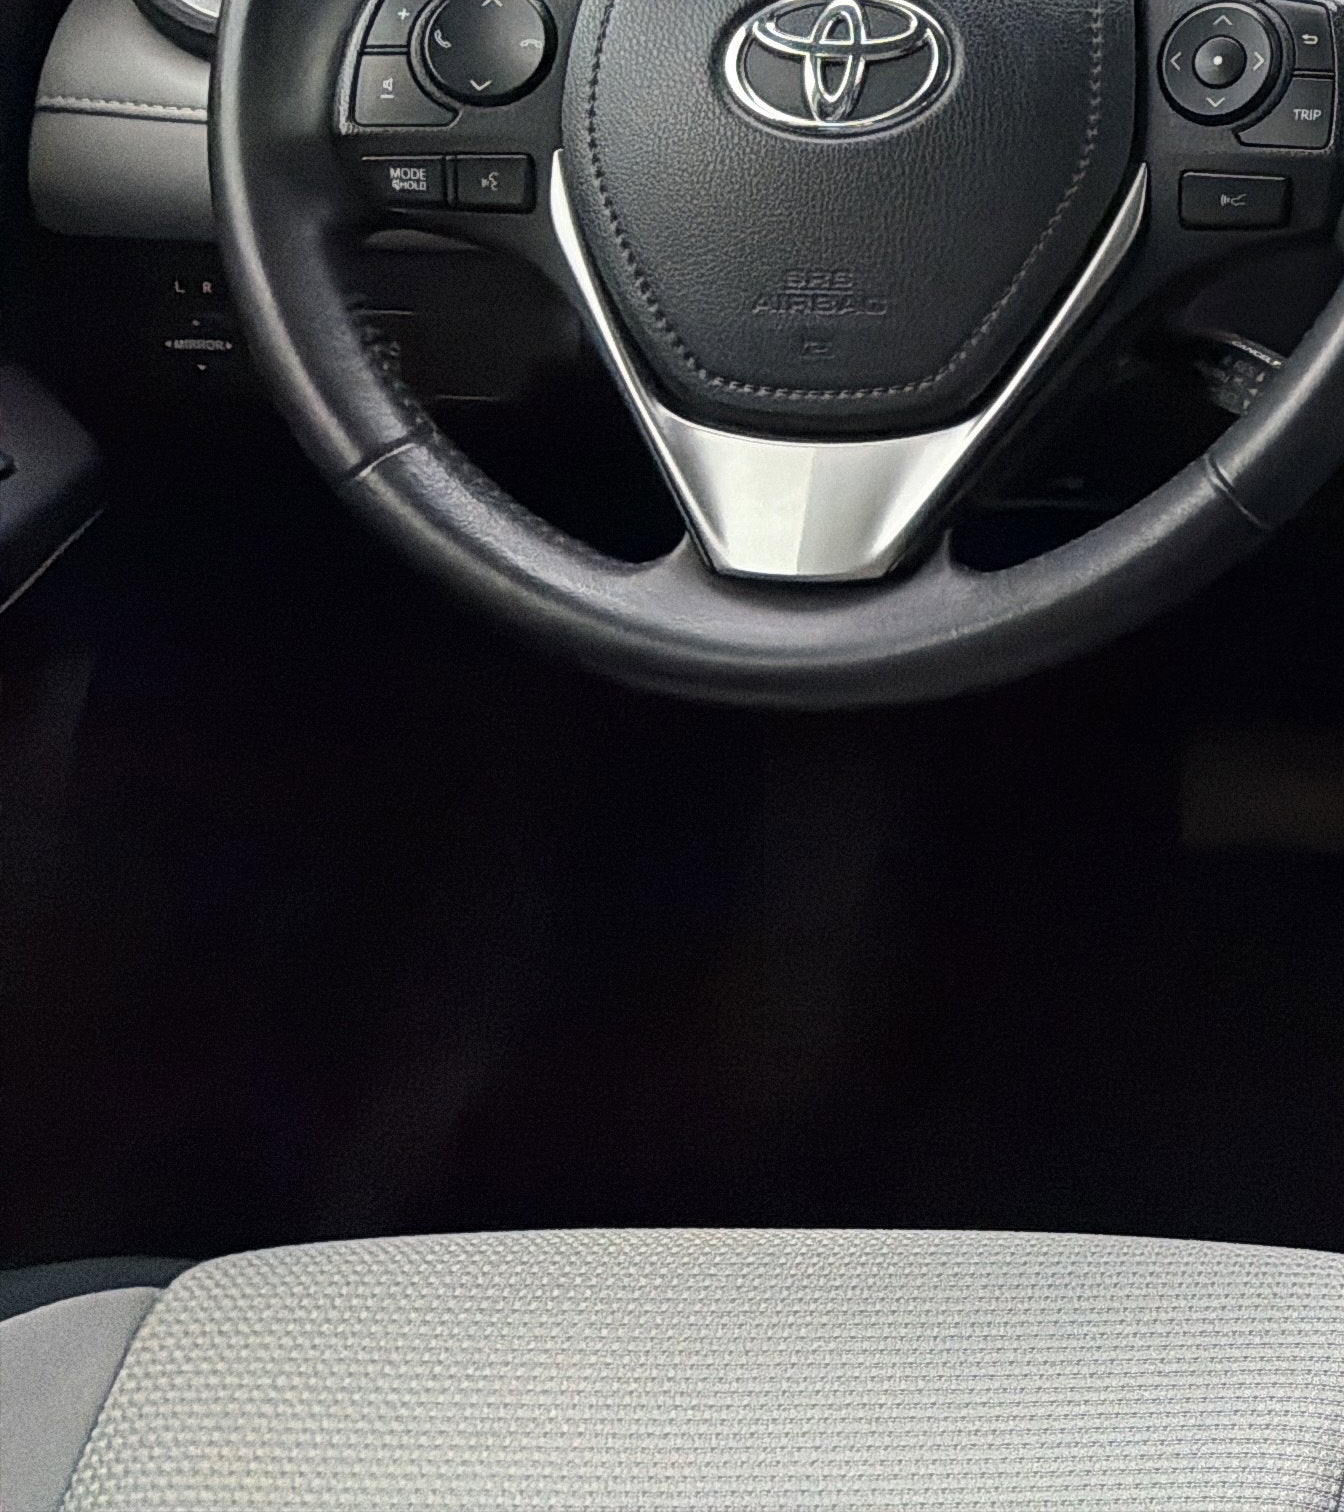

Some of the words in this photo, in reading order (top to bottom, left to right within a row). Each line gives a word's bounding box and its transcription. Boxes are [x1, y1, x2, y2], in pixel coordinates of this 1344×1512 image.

[1293, 109, 1322, 121] TRIP
[389, 167, 427, 181] MODE
[400, 180, 427, 191] HOLD
[785, 271, 853, 288] SRS
[174, 280, 186, 294] L
[202, 280, 213, 294] R
[751, 295, 888, 315] AIRBAG
[173, 338, 225, 351] MIRROR
